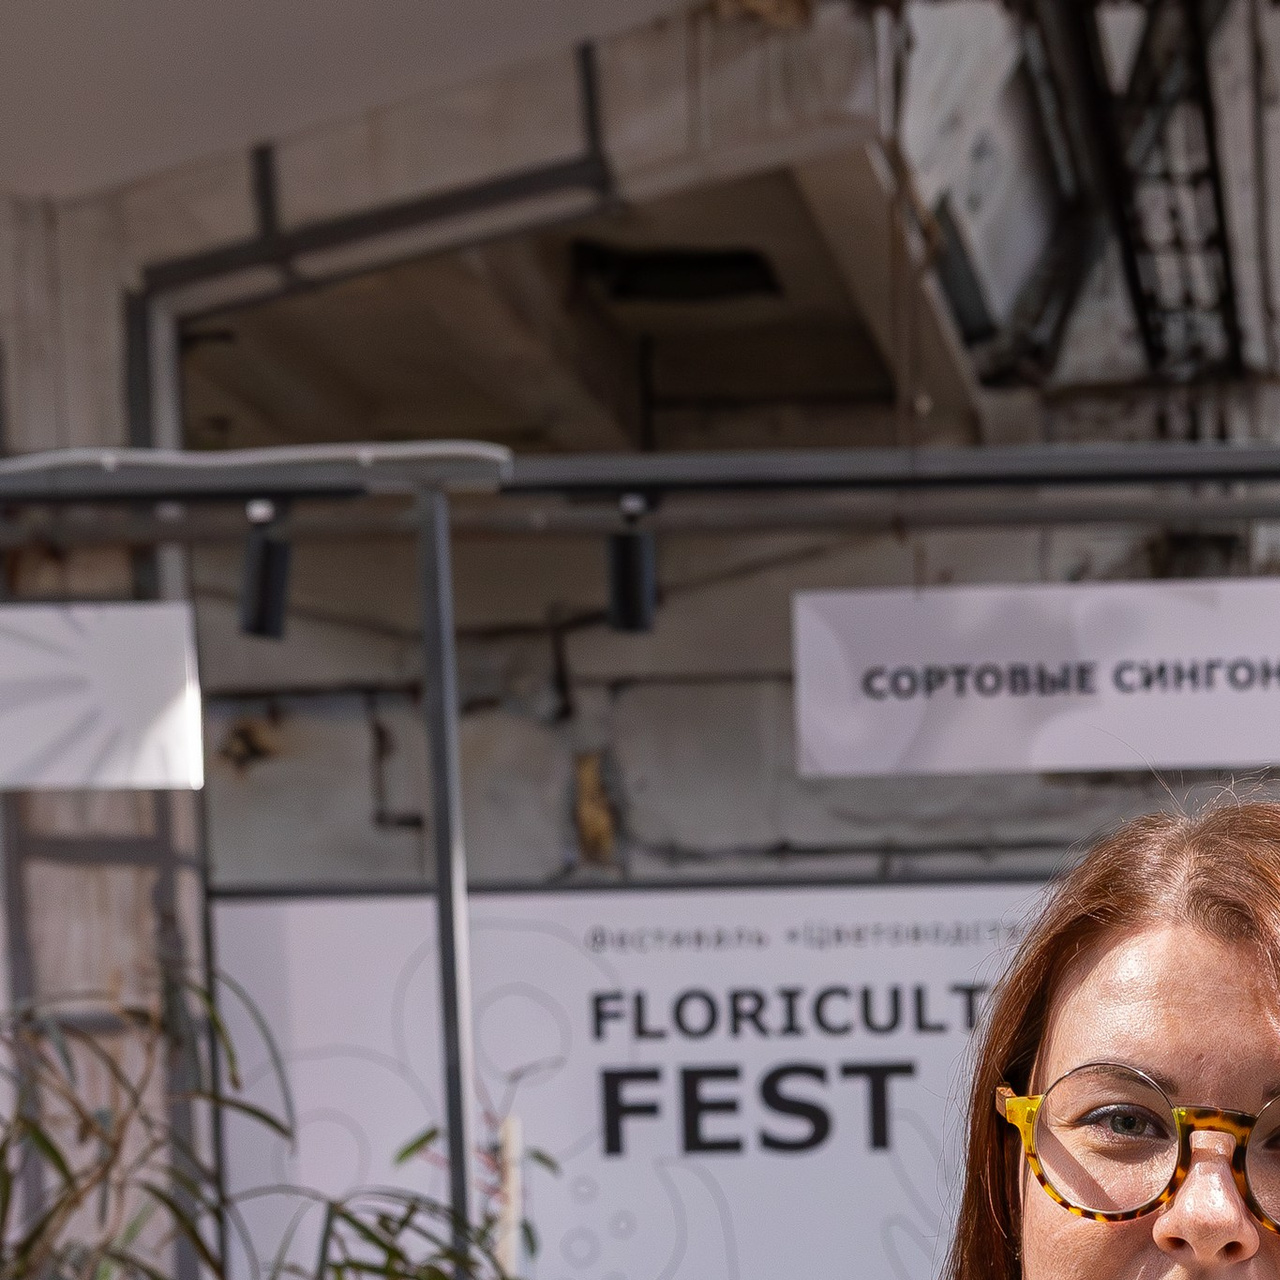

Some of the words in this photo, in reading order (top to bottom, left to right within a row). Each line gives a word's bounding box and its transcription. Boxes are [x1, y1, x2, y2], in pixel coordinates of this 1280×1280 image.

[862, 660, 1097, 700] СОРТОВЫЕ
[589, 983, 989, 1040] FLORICULT
[602, 1061, 916, 1156] FEST
